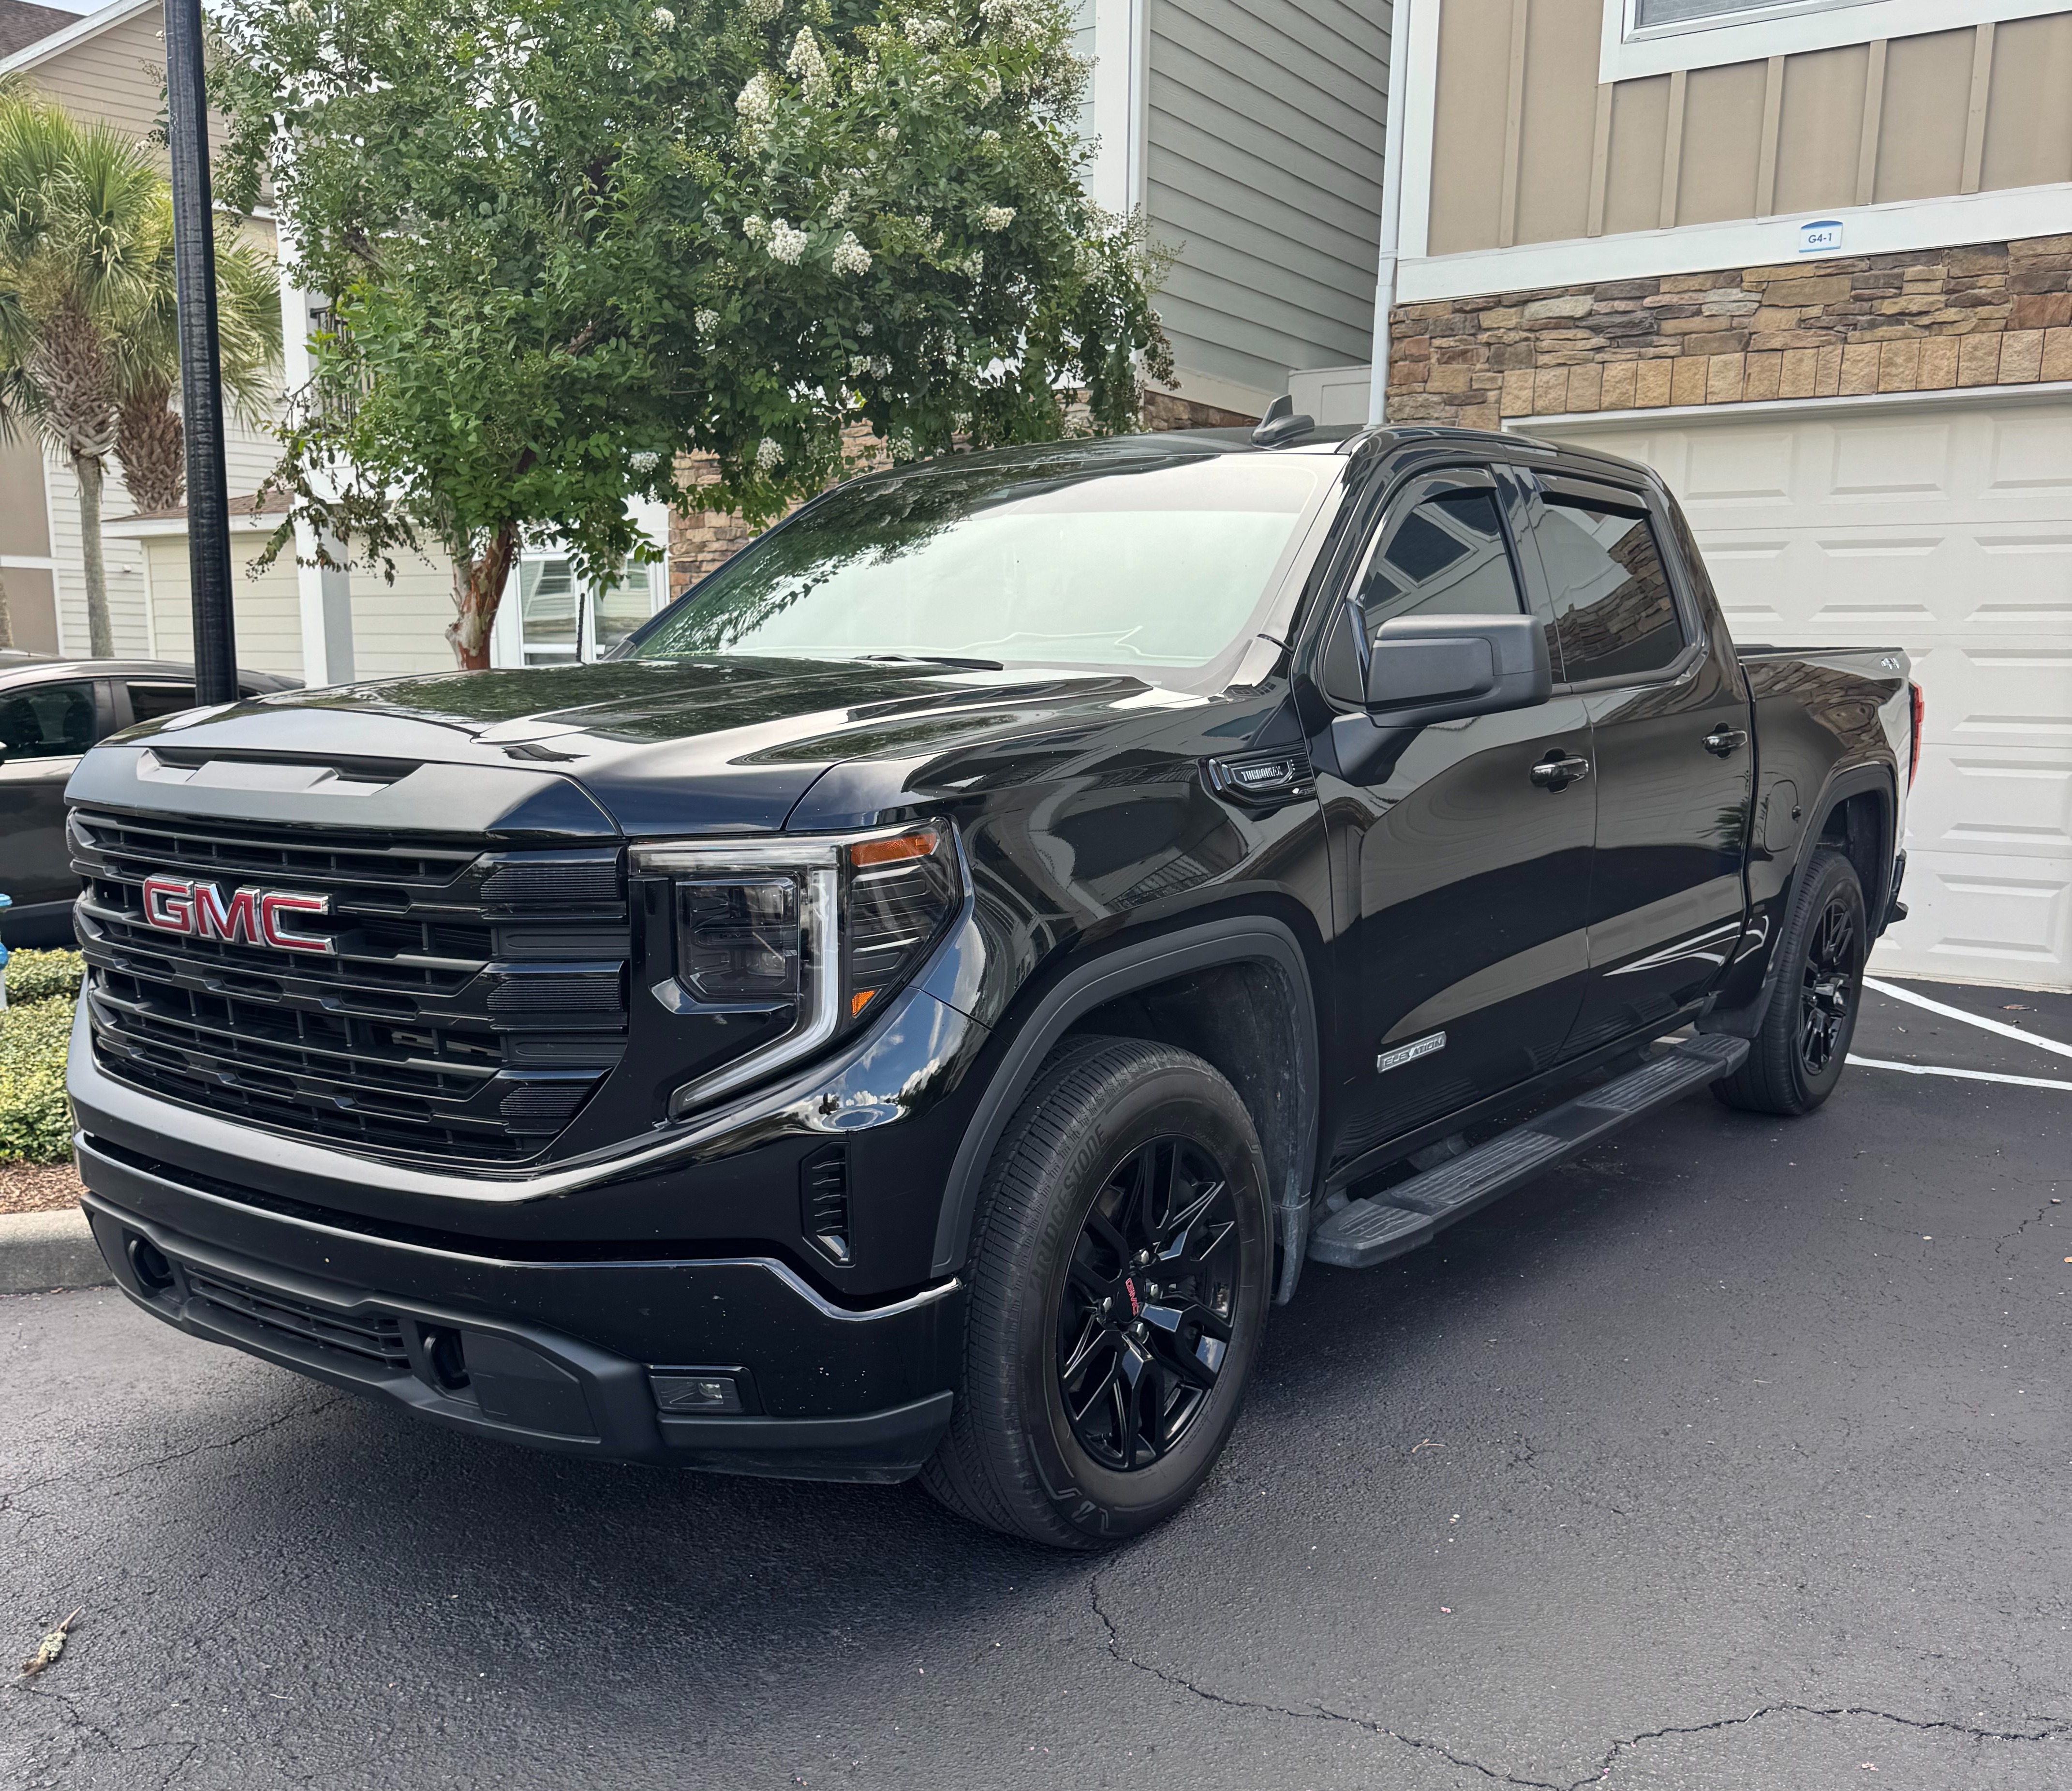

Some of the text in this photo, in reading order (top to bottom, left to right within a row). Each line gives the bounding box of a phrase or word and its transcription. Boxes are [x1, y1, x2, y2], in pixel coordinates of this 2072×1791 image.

[1808, 233, 1832, 243] G4-1
[1241, 765, 1283, 781] TURBOMAX
[142, 873, 338, 956] GMC
[1383, 1037, 1443, 1066] ELEVATION
[1028, 1122, 1108, 1294] BRIDGESTONE
[1125, 1277, 1140, 1317] GMC
